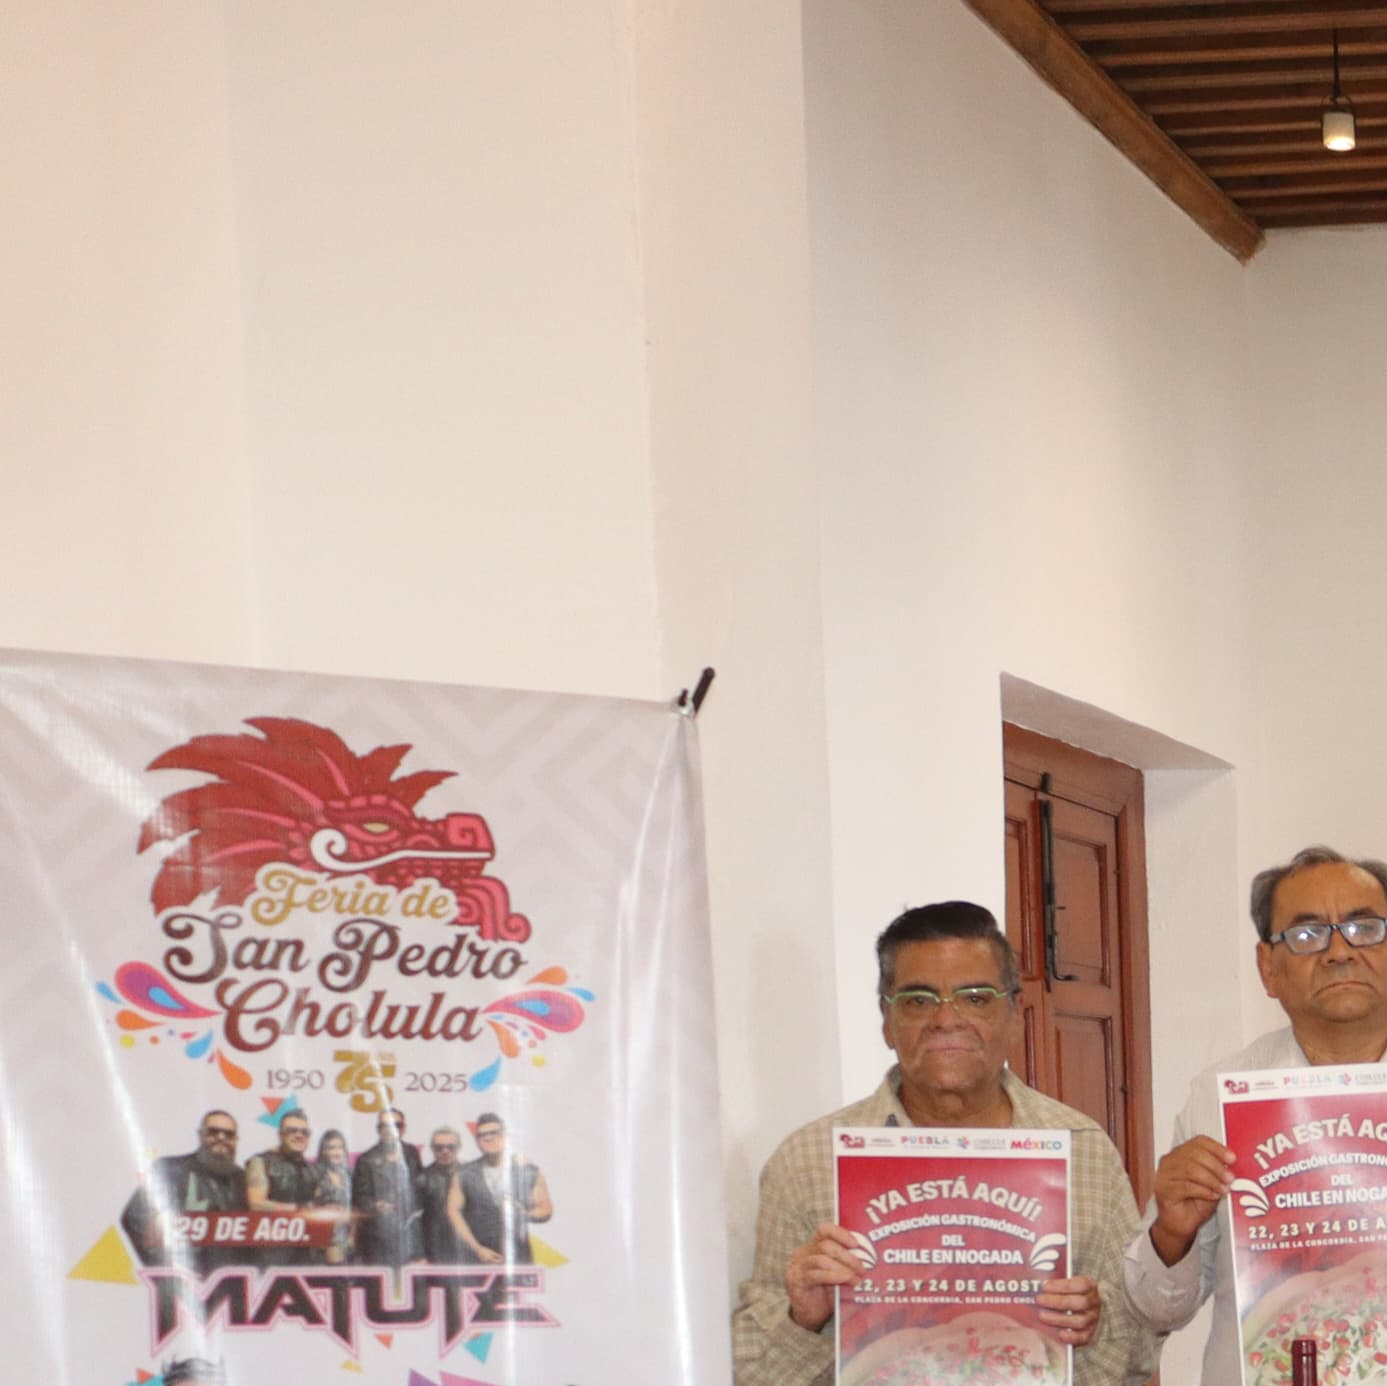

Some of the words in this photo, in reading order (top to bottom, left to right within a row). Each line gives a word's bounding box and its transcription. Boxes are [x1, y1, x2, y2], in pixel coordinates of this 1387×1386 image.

[253, 870, 389, 925] Feria
[401, 882, 451, 919] de
[164, 913, 309, 982] San
[318, 920, 527, 992] Pedro
[216, 978, 484, 1052] Cholula
[266, 1069, 325, 1091] 1950
[405, 1072, 468, 1093] 2025
[1254, 1134, 1293, 1170] ¡YA
[1293, 1113, 1354, 1145] ESTÁ
[1259, 1153, 1326, 1187] EXPOSICIÓN
[1331, 1174, 1354, 1185] DEL
[866, 1190, 907, 1225] ¡YA
[907, 1176, 968, 1202] ESTÁ
[972, 1183, 1043, 1221] AQUÍ!
[1275, 1191, 1321, 1208] CHILE
[1323, 1190, 1343, 1204] EN
[215, 1217, 246, 1241] DE
[254, 1217, 310, 1242] AGO.
[869, 1214, 939, 1241] EXPOSICIÓN
[942, 1215, 1036, 1242] GASTRONÓMICA
[942, 1234, 965, 1246] DEL
[883, 1250, 930, 1264] CHILE
[932, 1251, 953, 1264] EN
[955, 1250, 1023, 1264] NOGADA
[142, 1269, 558, 1354] MATUTE
